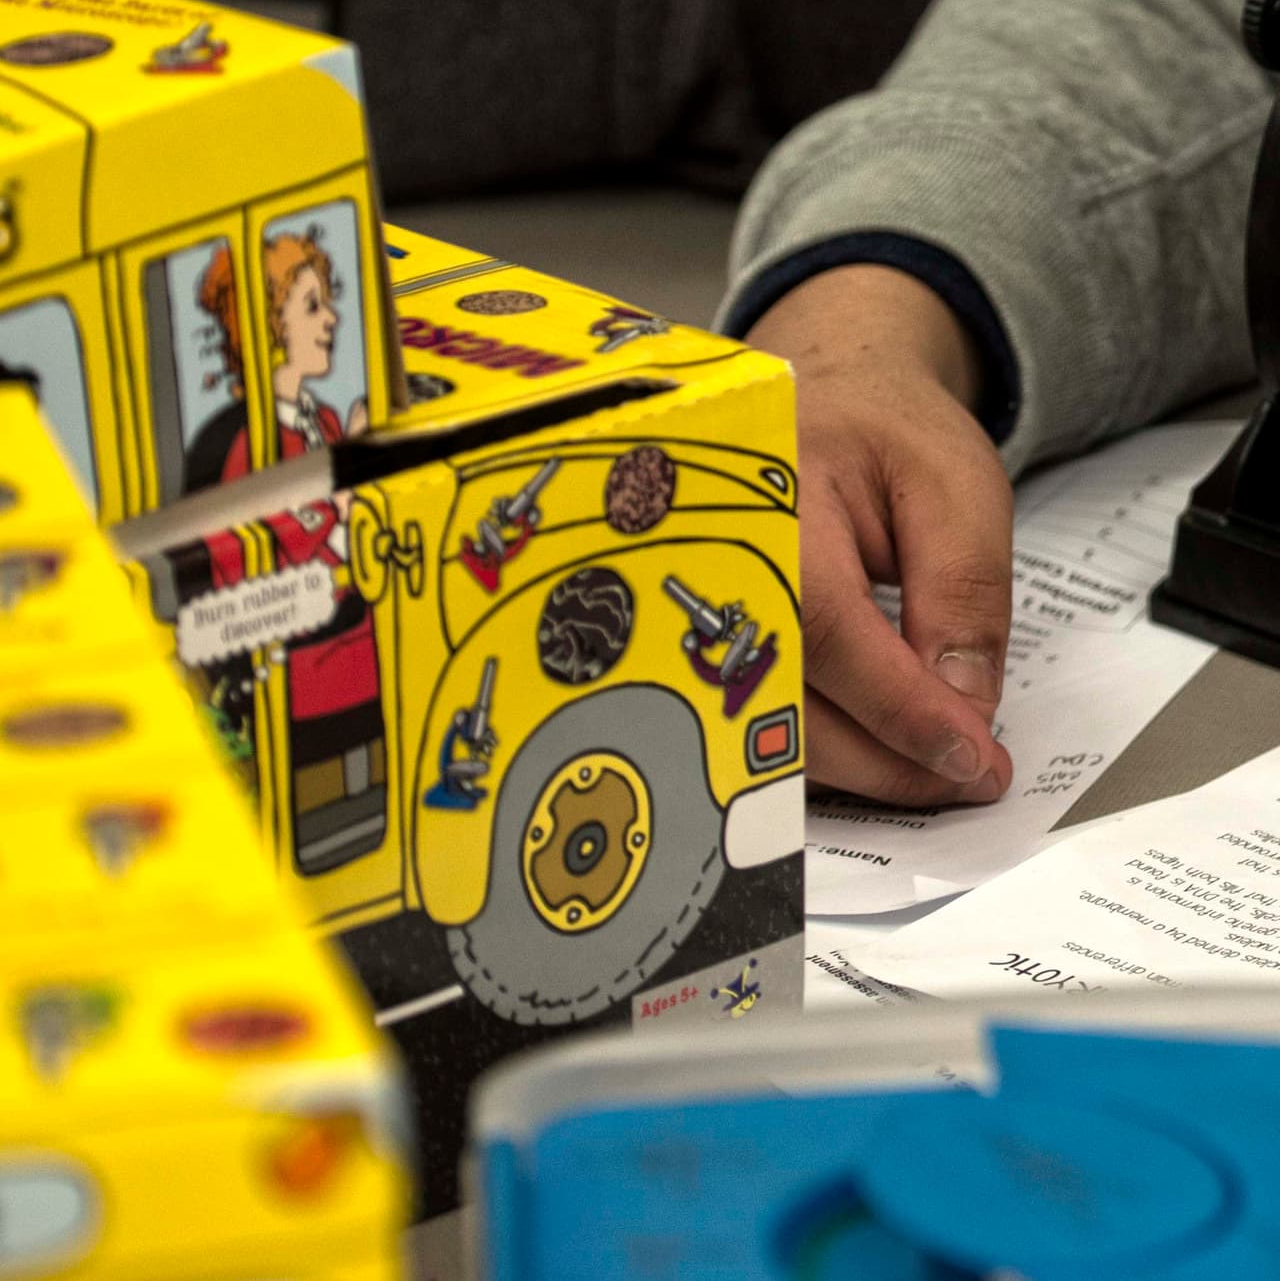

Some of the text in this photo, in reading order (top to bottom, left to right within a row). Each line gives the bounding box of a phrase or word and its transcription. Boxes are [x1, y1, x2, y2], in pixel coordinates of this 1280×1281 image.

[818, 846, 892, 866] Name:
[1137, 849, 1184, 870] types
[1125, 859, 1174, 880] found
[1237, 859, 1271, 873] that
[1127, 877, 1142, 885] is
[1170, 878, 1186, 887] is
[1185, 867, 1220, 885] both
[1184, 884, 1220, 901] DNA
[1243, 892, 1278, 906] that
[1080, 890, 1154, 925] membrane,
[1219, 898, 1245, 911] the
[1165, 927, 1186, 941] by
[1224, 918, 1280, 935] genetic
[1181, 934, 1240, 958] defined
[1062, 942, 1146, 974] differences
[806, 954, 879, 999] assessment
[639, 999, 677, 1020] Ages
